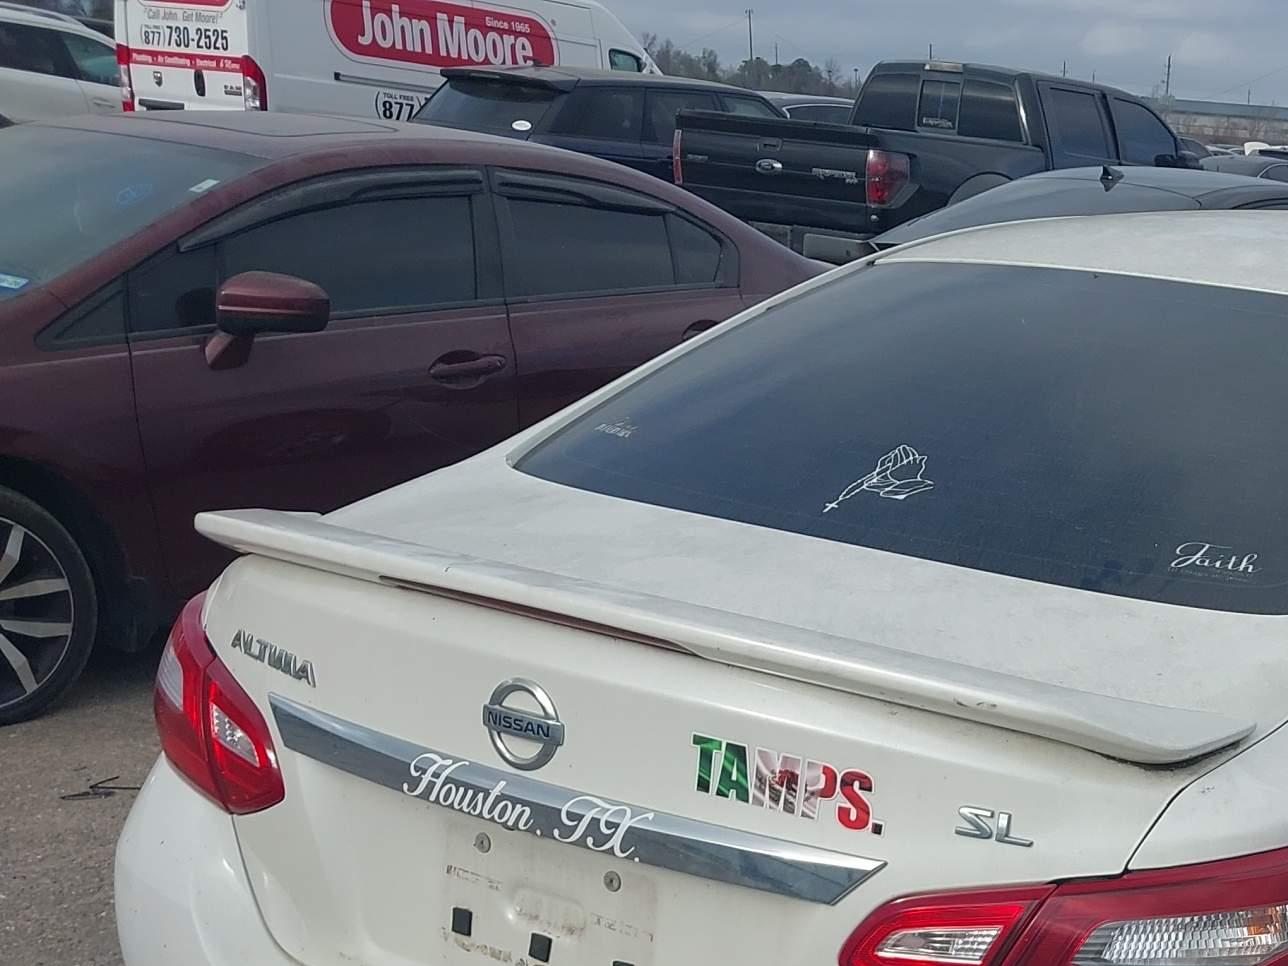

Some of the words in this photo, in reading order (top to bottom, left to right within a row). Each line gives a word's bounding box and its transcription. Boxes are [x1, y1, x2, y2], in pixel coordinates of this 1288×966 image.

[166, 25, 229, 51] 730-2525
[358, 0, 433, 54] John
[436, 12, 533, 66] Moore
[485, 16, 509, 30] Since
[511, 21, 530, 33] 1965
[1170, 541, 1262, 573] Faith
[231, 629, 316, 689] ALTIMA
[487, 711, 550, 738] NISSAN
[955, 804, 1034, 848] SL
